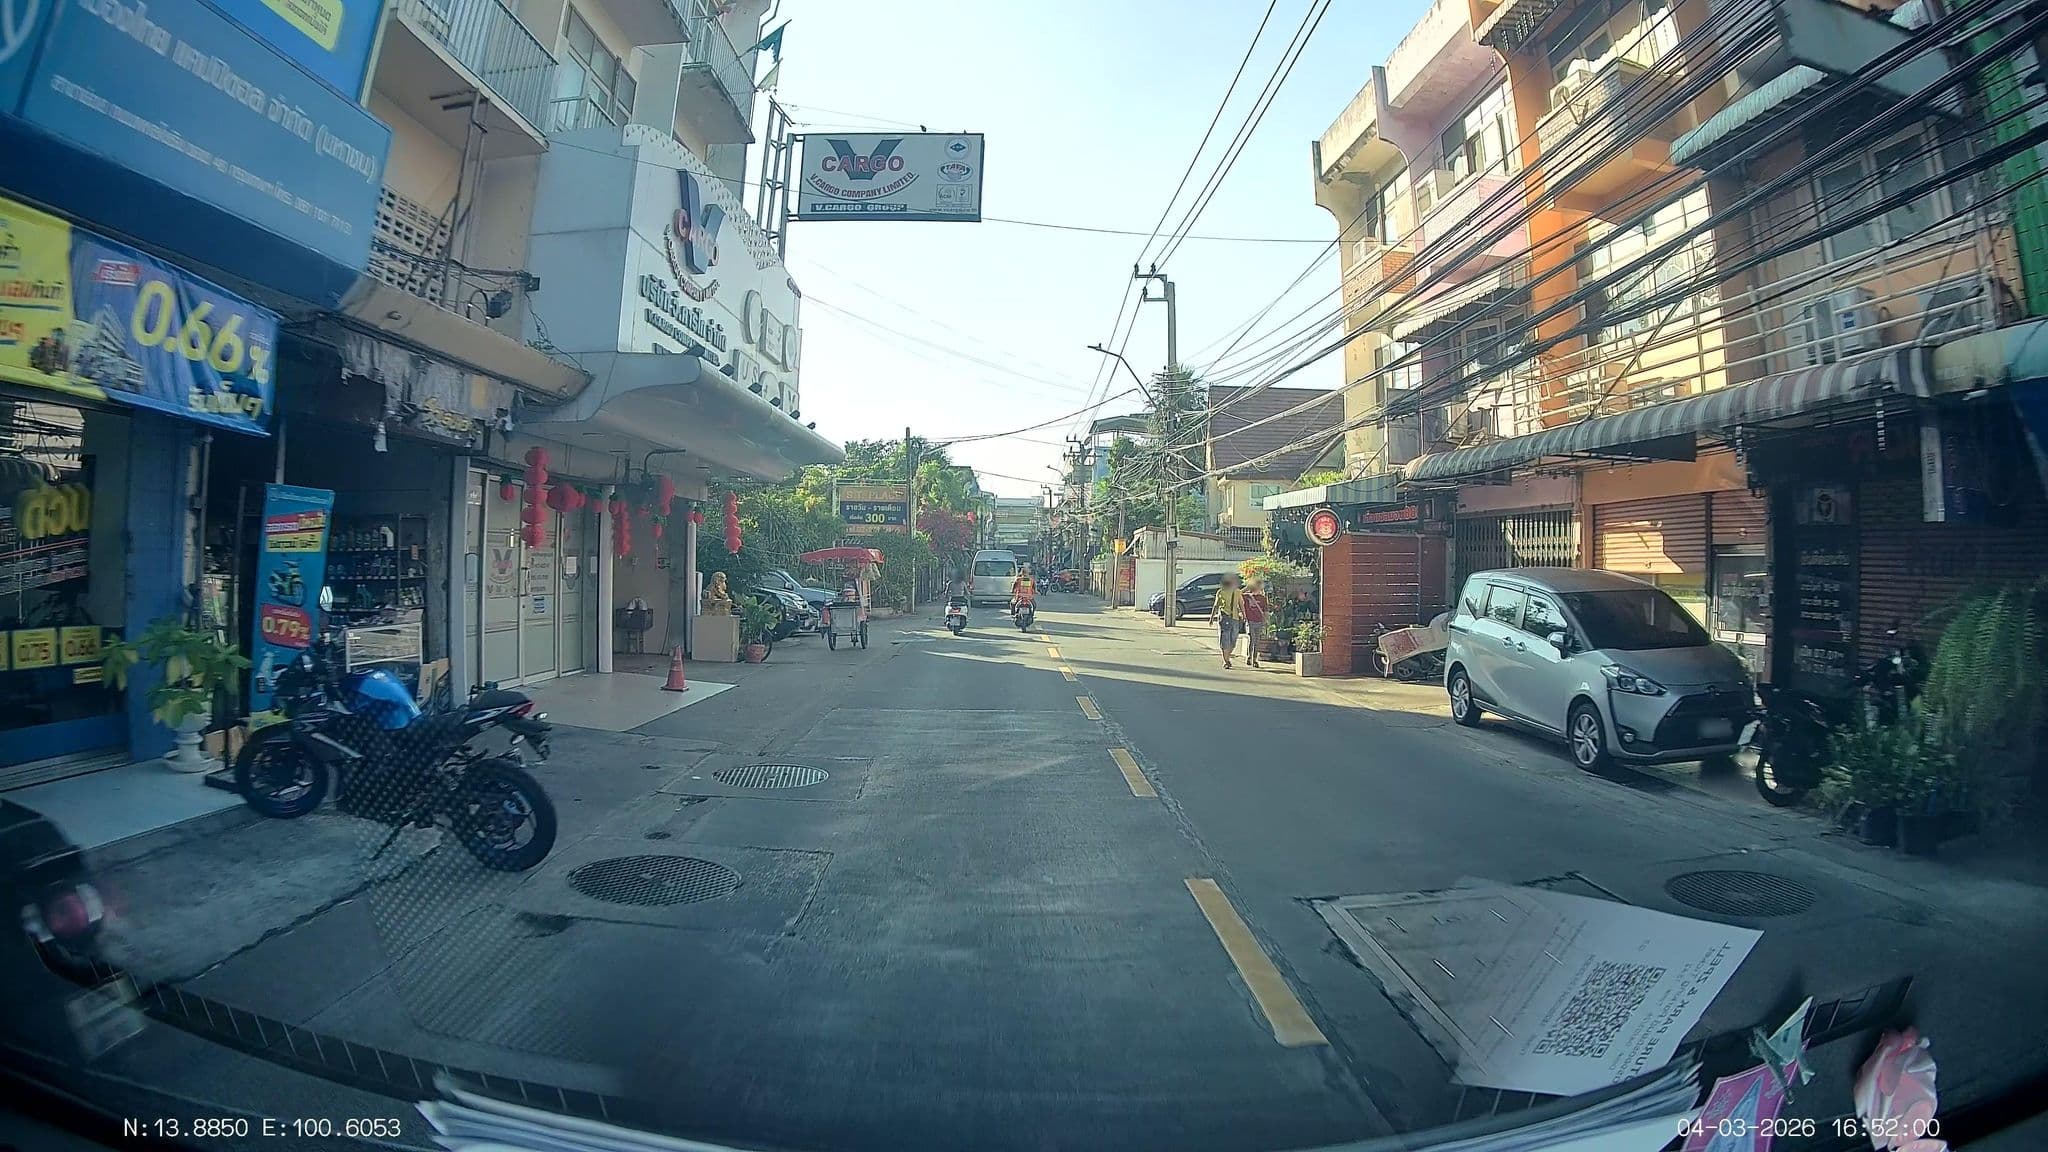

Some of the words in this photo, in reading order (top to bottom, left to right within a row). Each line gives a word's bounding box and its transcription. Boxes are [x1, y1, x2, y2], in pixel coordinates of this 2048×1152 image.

[315, 124, 378, 184] (มหาชน)
[822, 155, 904, 172] CARGO
[810, 173, 839, 195] V.CARGO
[841, 188, 882, 199] COMPANY
[815, 204, 862, 212] V.CARGO
[866, 204, 905, 212] GROUP
[865, 513, 885, 523] 300
